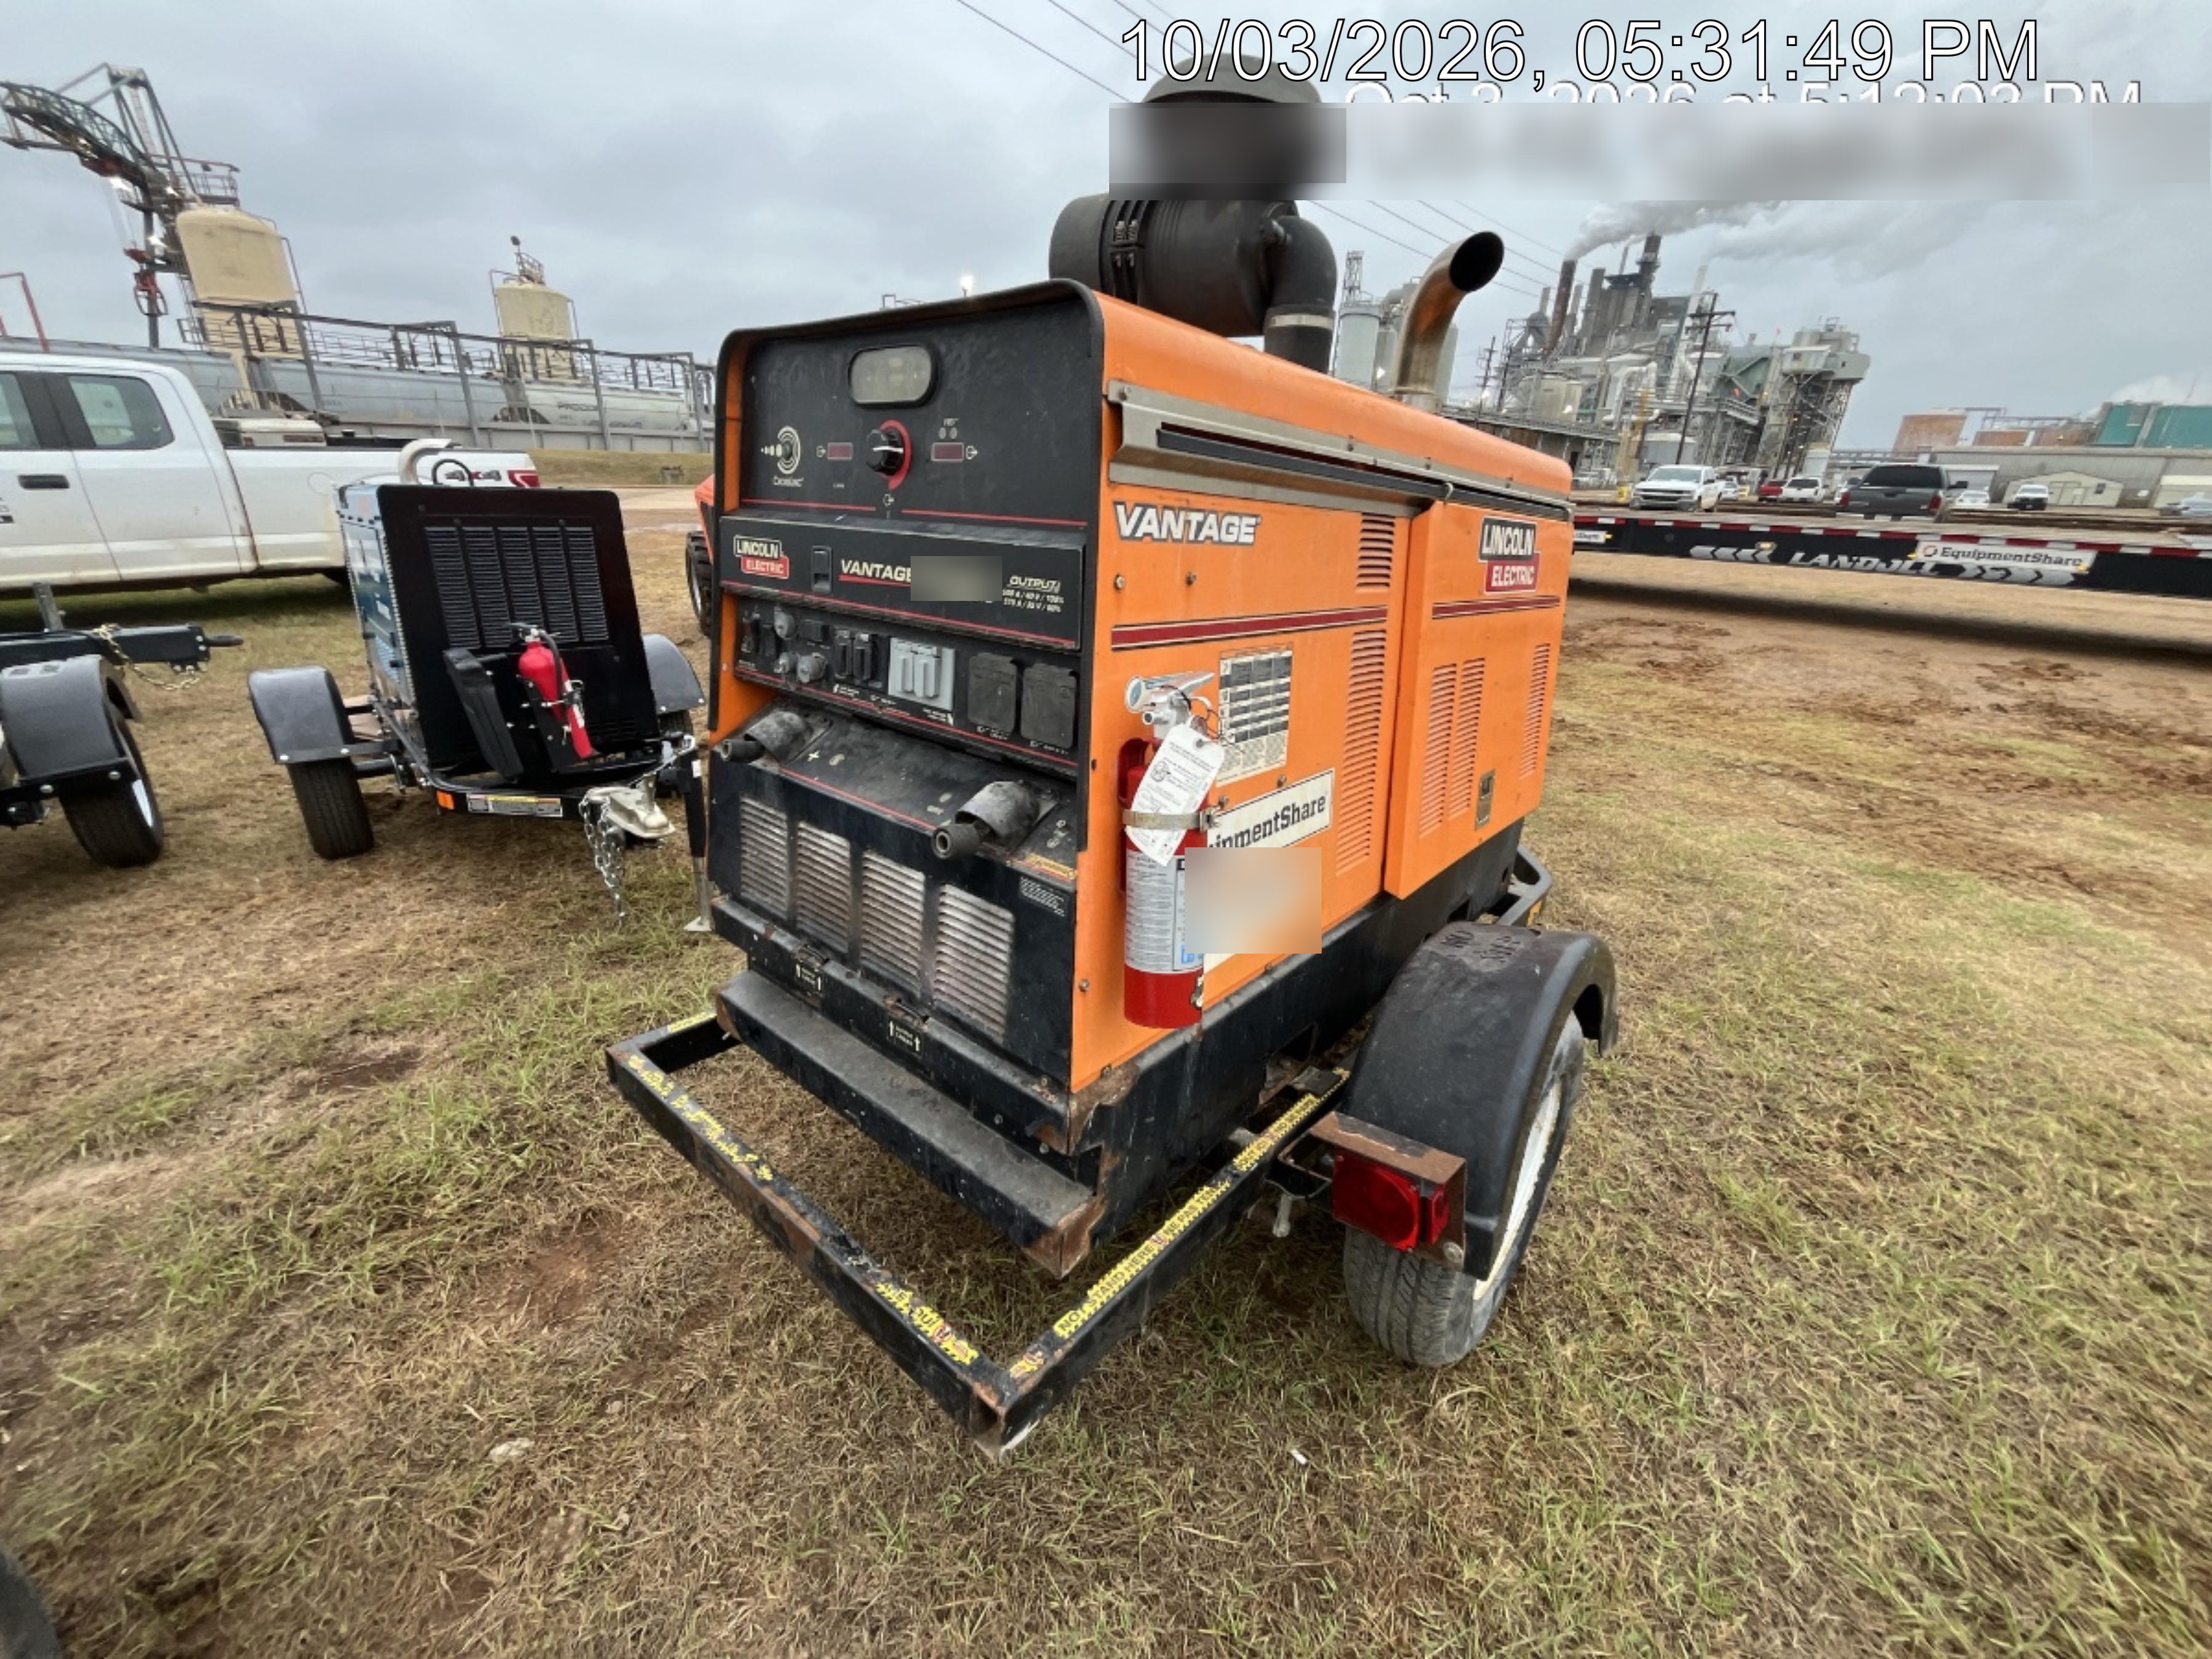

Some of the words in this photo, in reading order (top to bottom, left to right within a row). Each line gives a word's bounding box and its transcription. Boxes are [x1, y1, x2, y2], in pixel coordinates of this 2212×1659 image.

[1113, 501, 1260, 546] VANTAGE
[737, 540, 779, 559] LINCOLN
[1481, 524, 1534, 556] LINCOLN
[1941, 546, 2084, 567] EquipmentShare
[746, 560, 784, 575] ELECTRIC
[1491, 565, 1534, 587] ELECTRIC
[1009, 576, 1058, 592] OUTPUT
